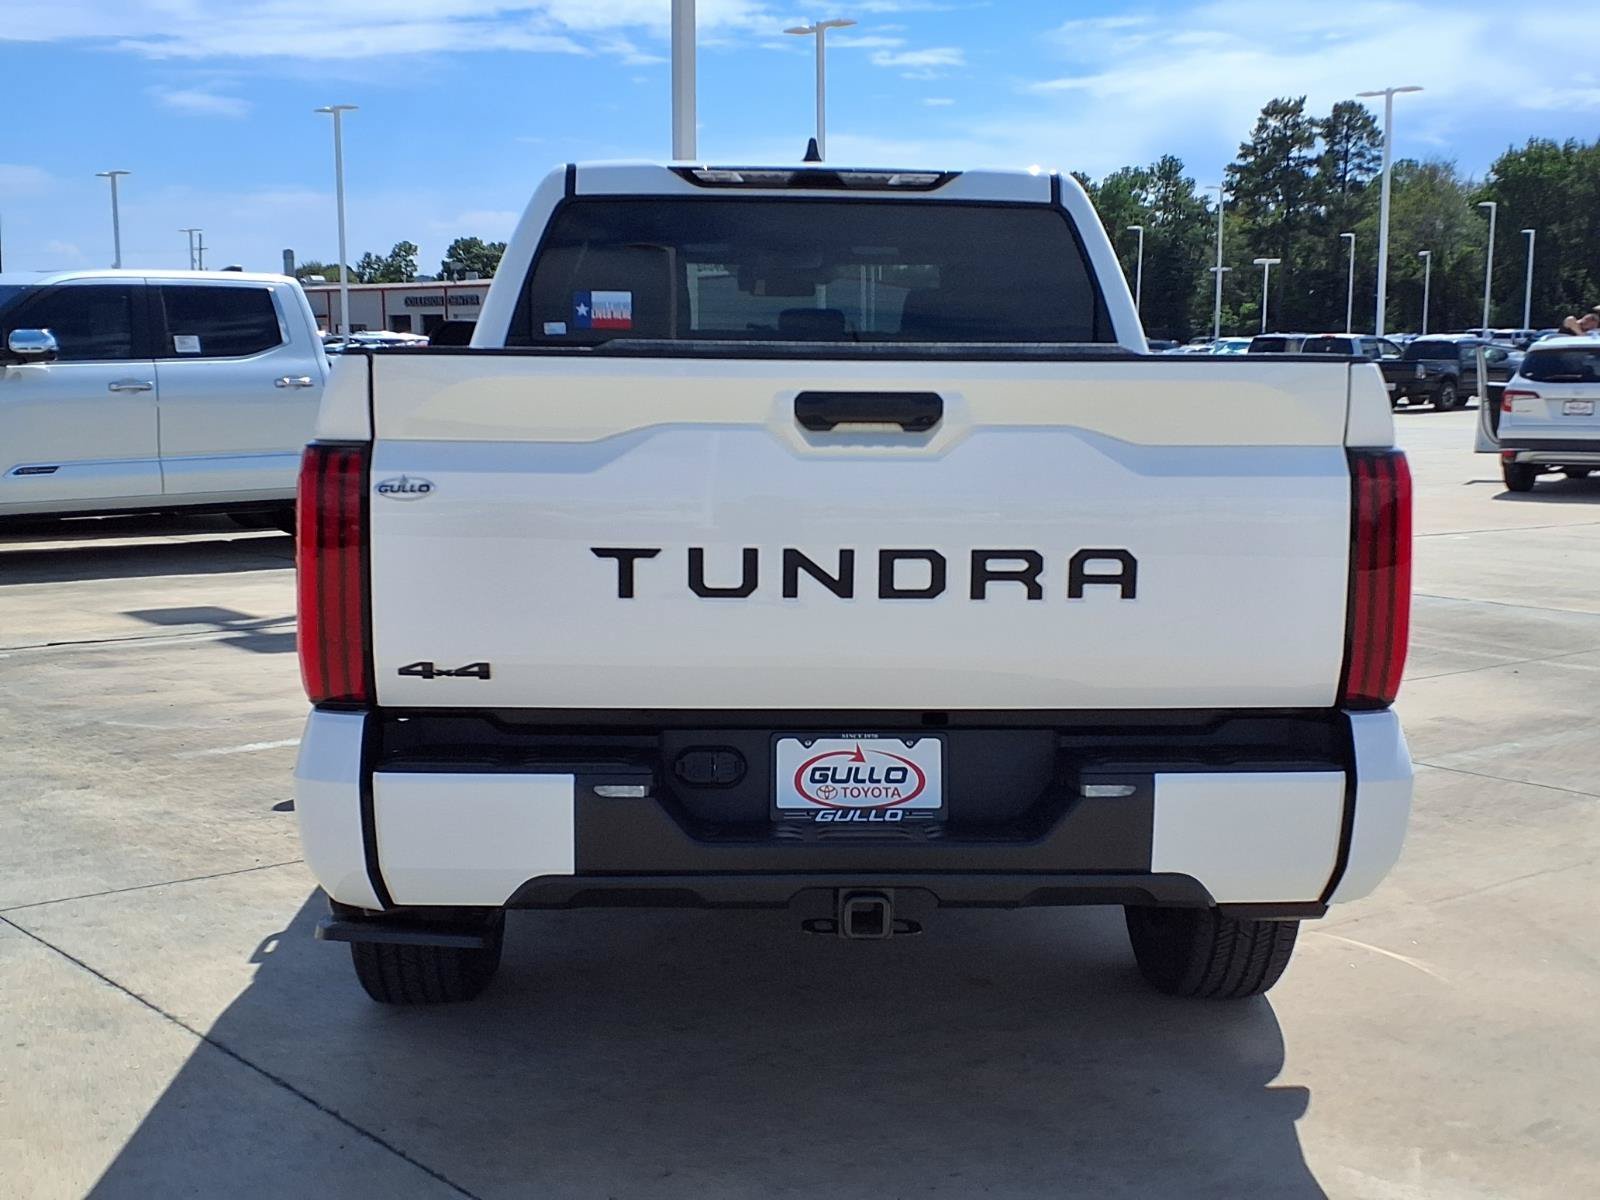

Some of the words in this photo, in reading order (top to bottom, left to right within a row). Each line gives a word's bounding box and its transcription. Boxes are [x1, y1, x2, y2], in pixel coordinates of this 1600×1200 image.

[377, 484, 431, 494] GULLO
[590, 547, 1137, 600] TUNDRA
[398, 661, 491, 680] 4x4
[809, 766, 909, 784] GULLO
[841, 786, 902, 799] TOYOTA
[815, 809, 904, 822] GULLO
